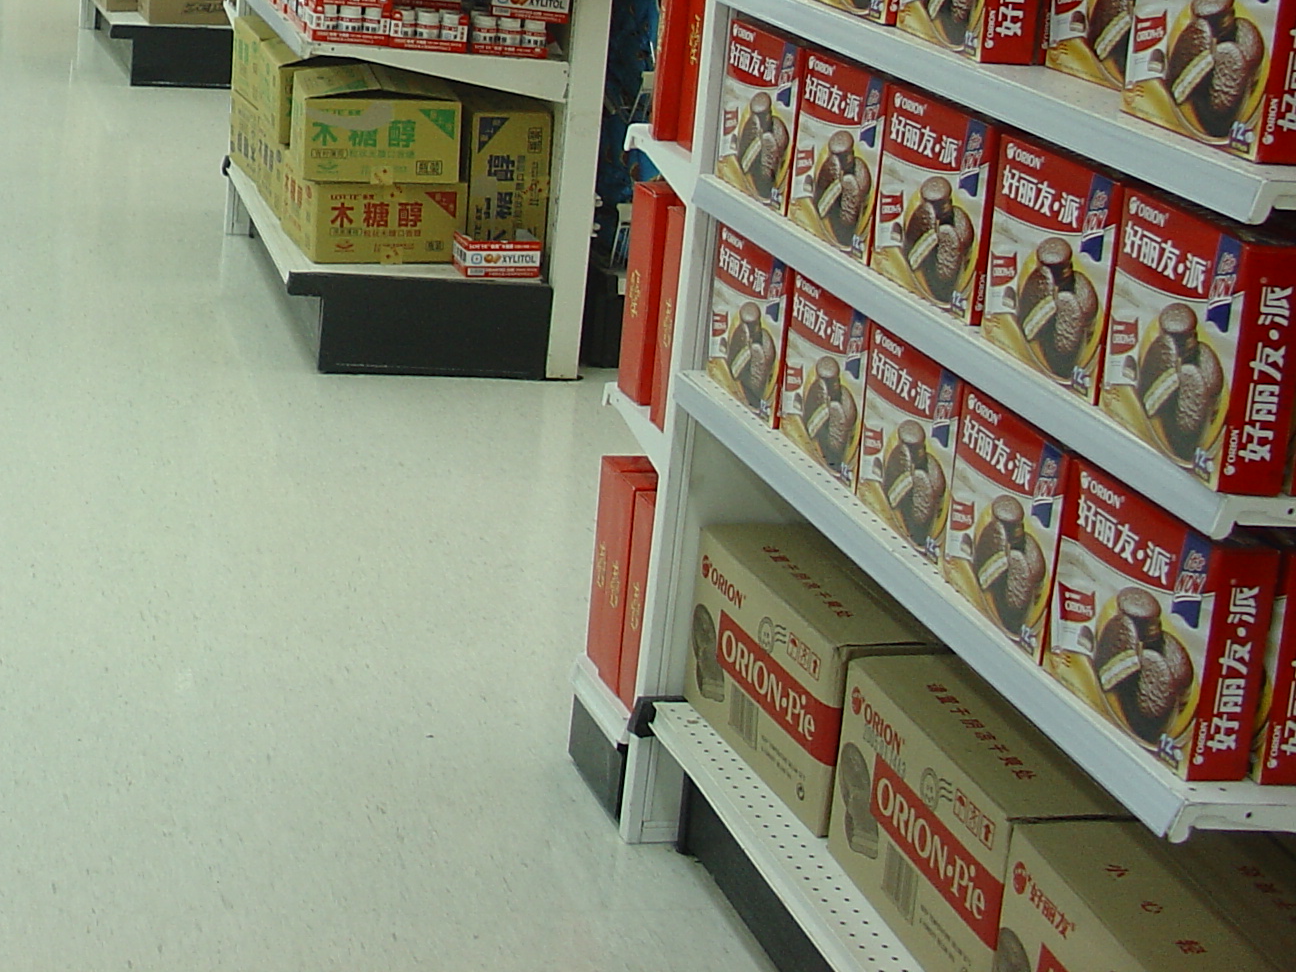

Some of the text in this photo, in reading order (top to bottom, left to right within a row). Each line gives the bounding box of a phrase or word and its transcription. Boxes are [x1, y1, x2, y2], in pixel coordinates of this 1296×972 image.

[1015, 147, 1045, 169] ORION
[331, 202, 423, 227] 木糖醇
[1002, 166, 1080, 227] 好丽友·派
[1138, 199, 1168, 226] ORION
[502, 254, 536, 264] XYLITOL
[1123, 222, 1206, 293] 好丽友·派
[976, 397, 1002, 425] ORION
[962, 418, 1031, 491] 好丽友·派
[1090, 482, 1123, 509] ORION
[1077, 496, 1171, 585] 好丽友·派
[711, 568, 746, 608] ORION
[1204, 585, 1260, 751] 好丽友·派
[863, 704, 904, 748] ORION
